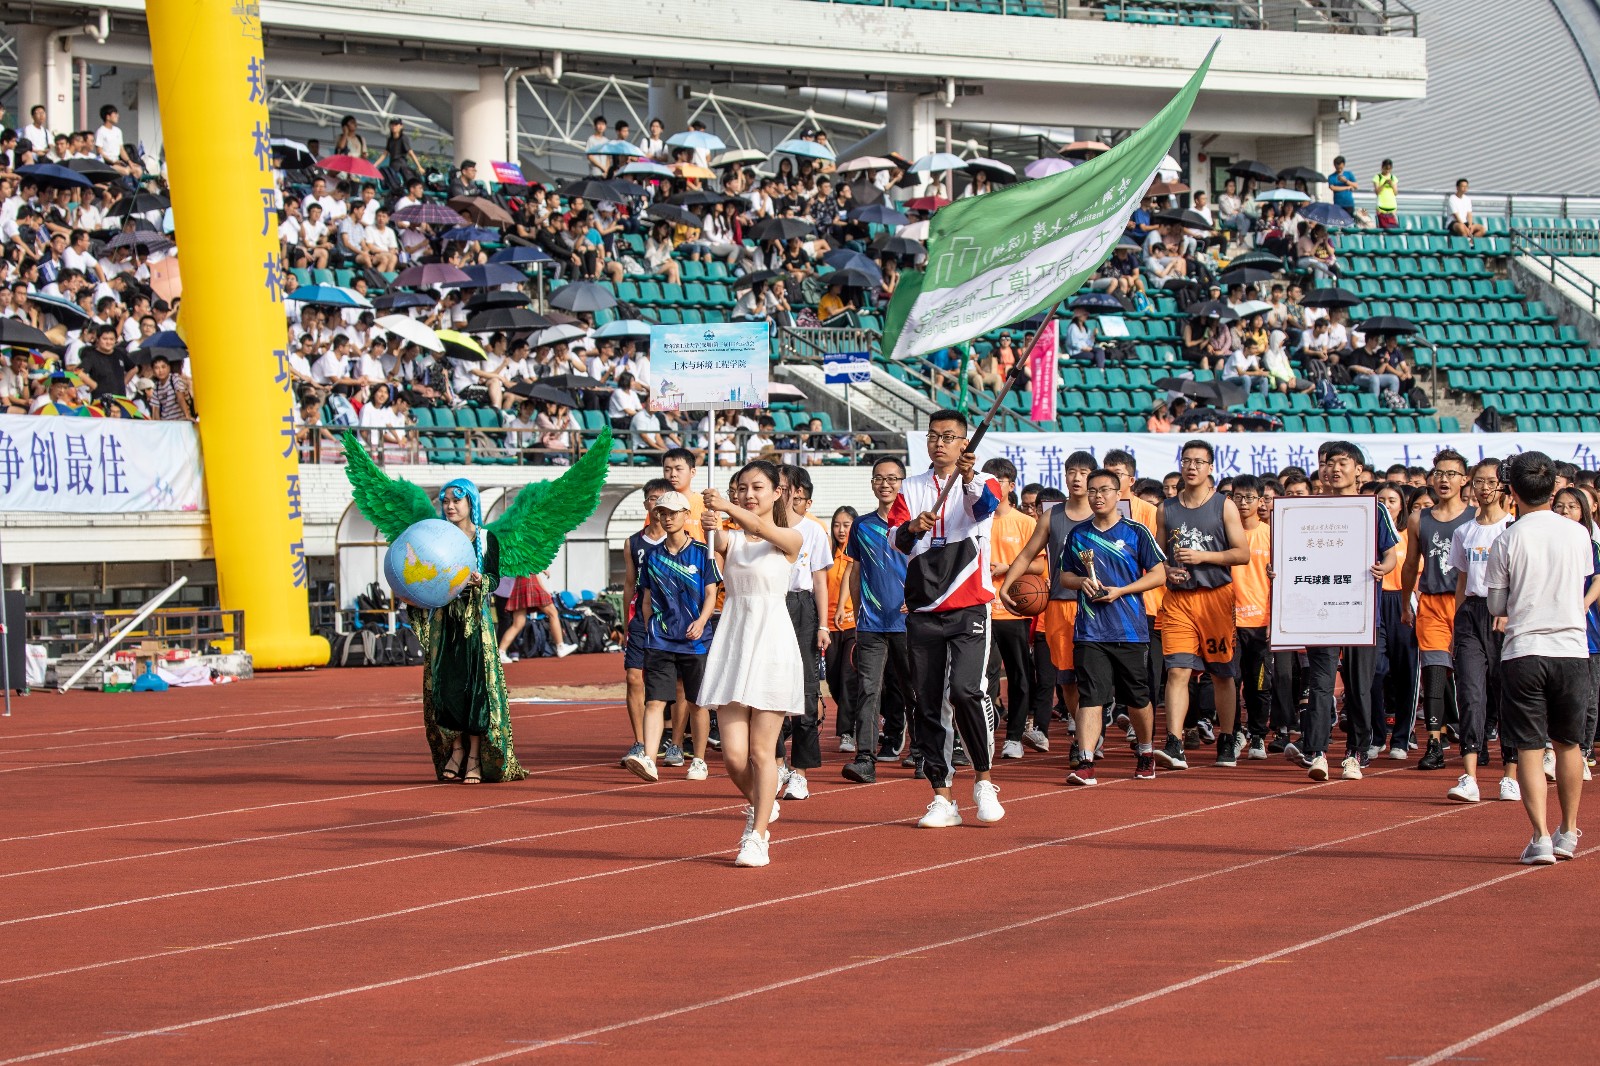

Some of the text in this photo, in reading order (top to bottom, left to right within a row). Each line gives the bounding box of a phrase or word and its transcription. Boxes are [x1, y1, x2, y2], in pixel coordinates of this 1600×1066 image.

[671, 359, 747, 371] 土木与环境工程学院
[0, 429, 129, 496] 争创最佳
[1293, 574, 1352, 585] 乒乓球赛 冠军
[1206, 637, 1228, 655] 34
